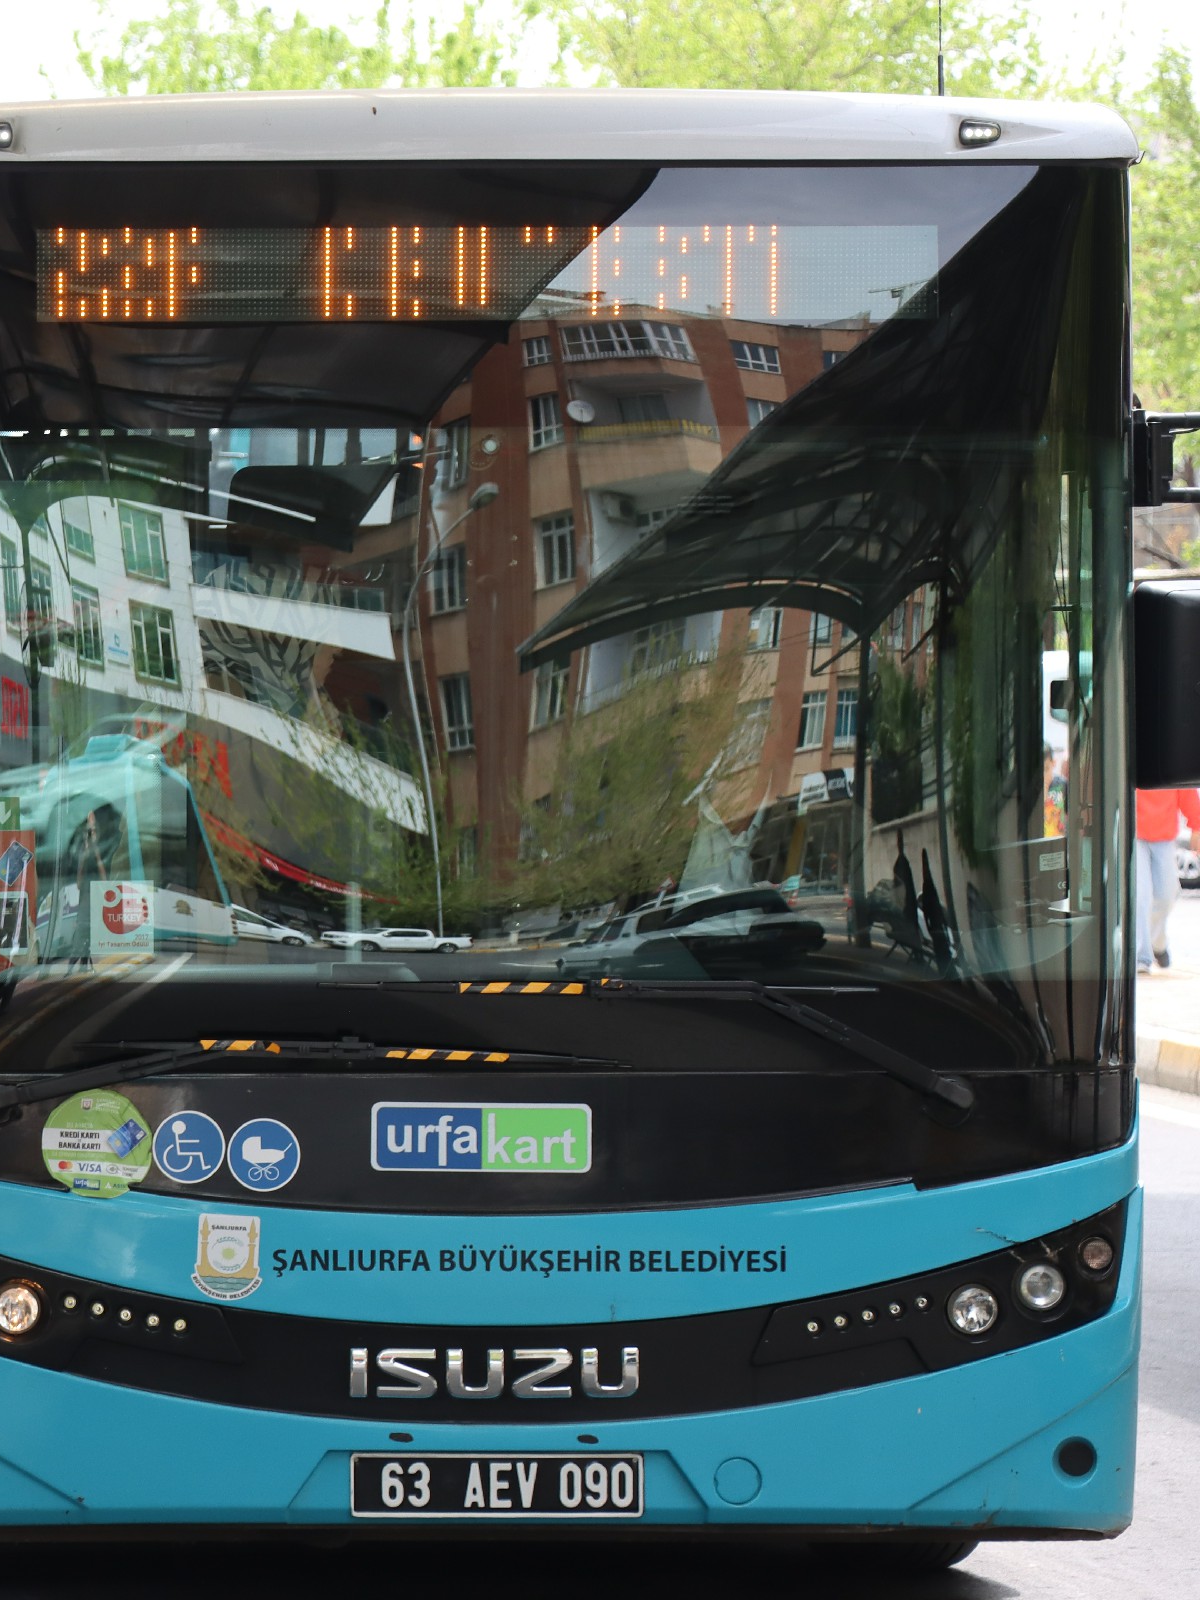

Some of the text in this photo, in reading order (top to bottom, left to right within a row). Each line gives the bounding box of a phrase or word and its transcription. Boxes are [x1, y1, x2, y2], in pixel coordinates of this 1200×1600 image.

[107, 913, 141, 923] TURKEY
[58, 1141, 101, 1150] BANKA KARTI
[59, 1130, 100, 1140] KREDİ KARTI
[386, 1112, 577, 1167] urfakart
[77, 1162, 102, 1173] VISA
[272, 1244, 787, 1278] ŞANLIURFA BÜYÜKŞEHİR BELEDİYESİ
[350, 1347, 640, 1398] ISUZU
[381, 1462, 634, 1508] 63 AEV 090
